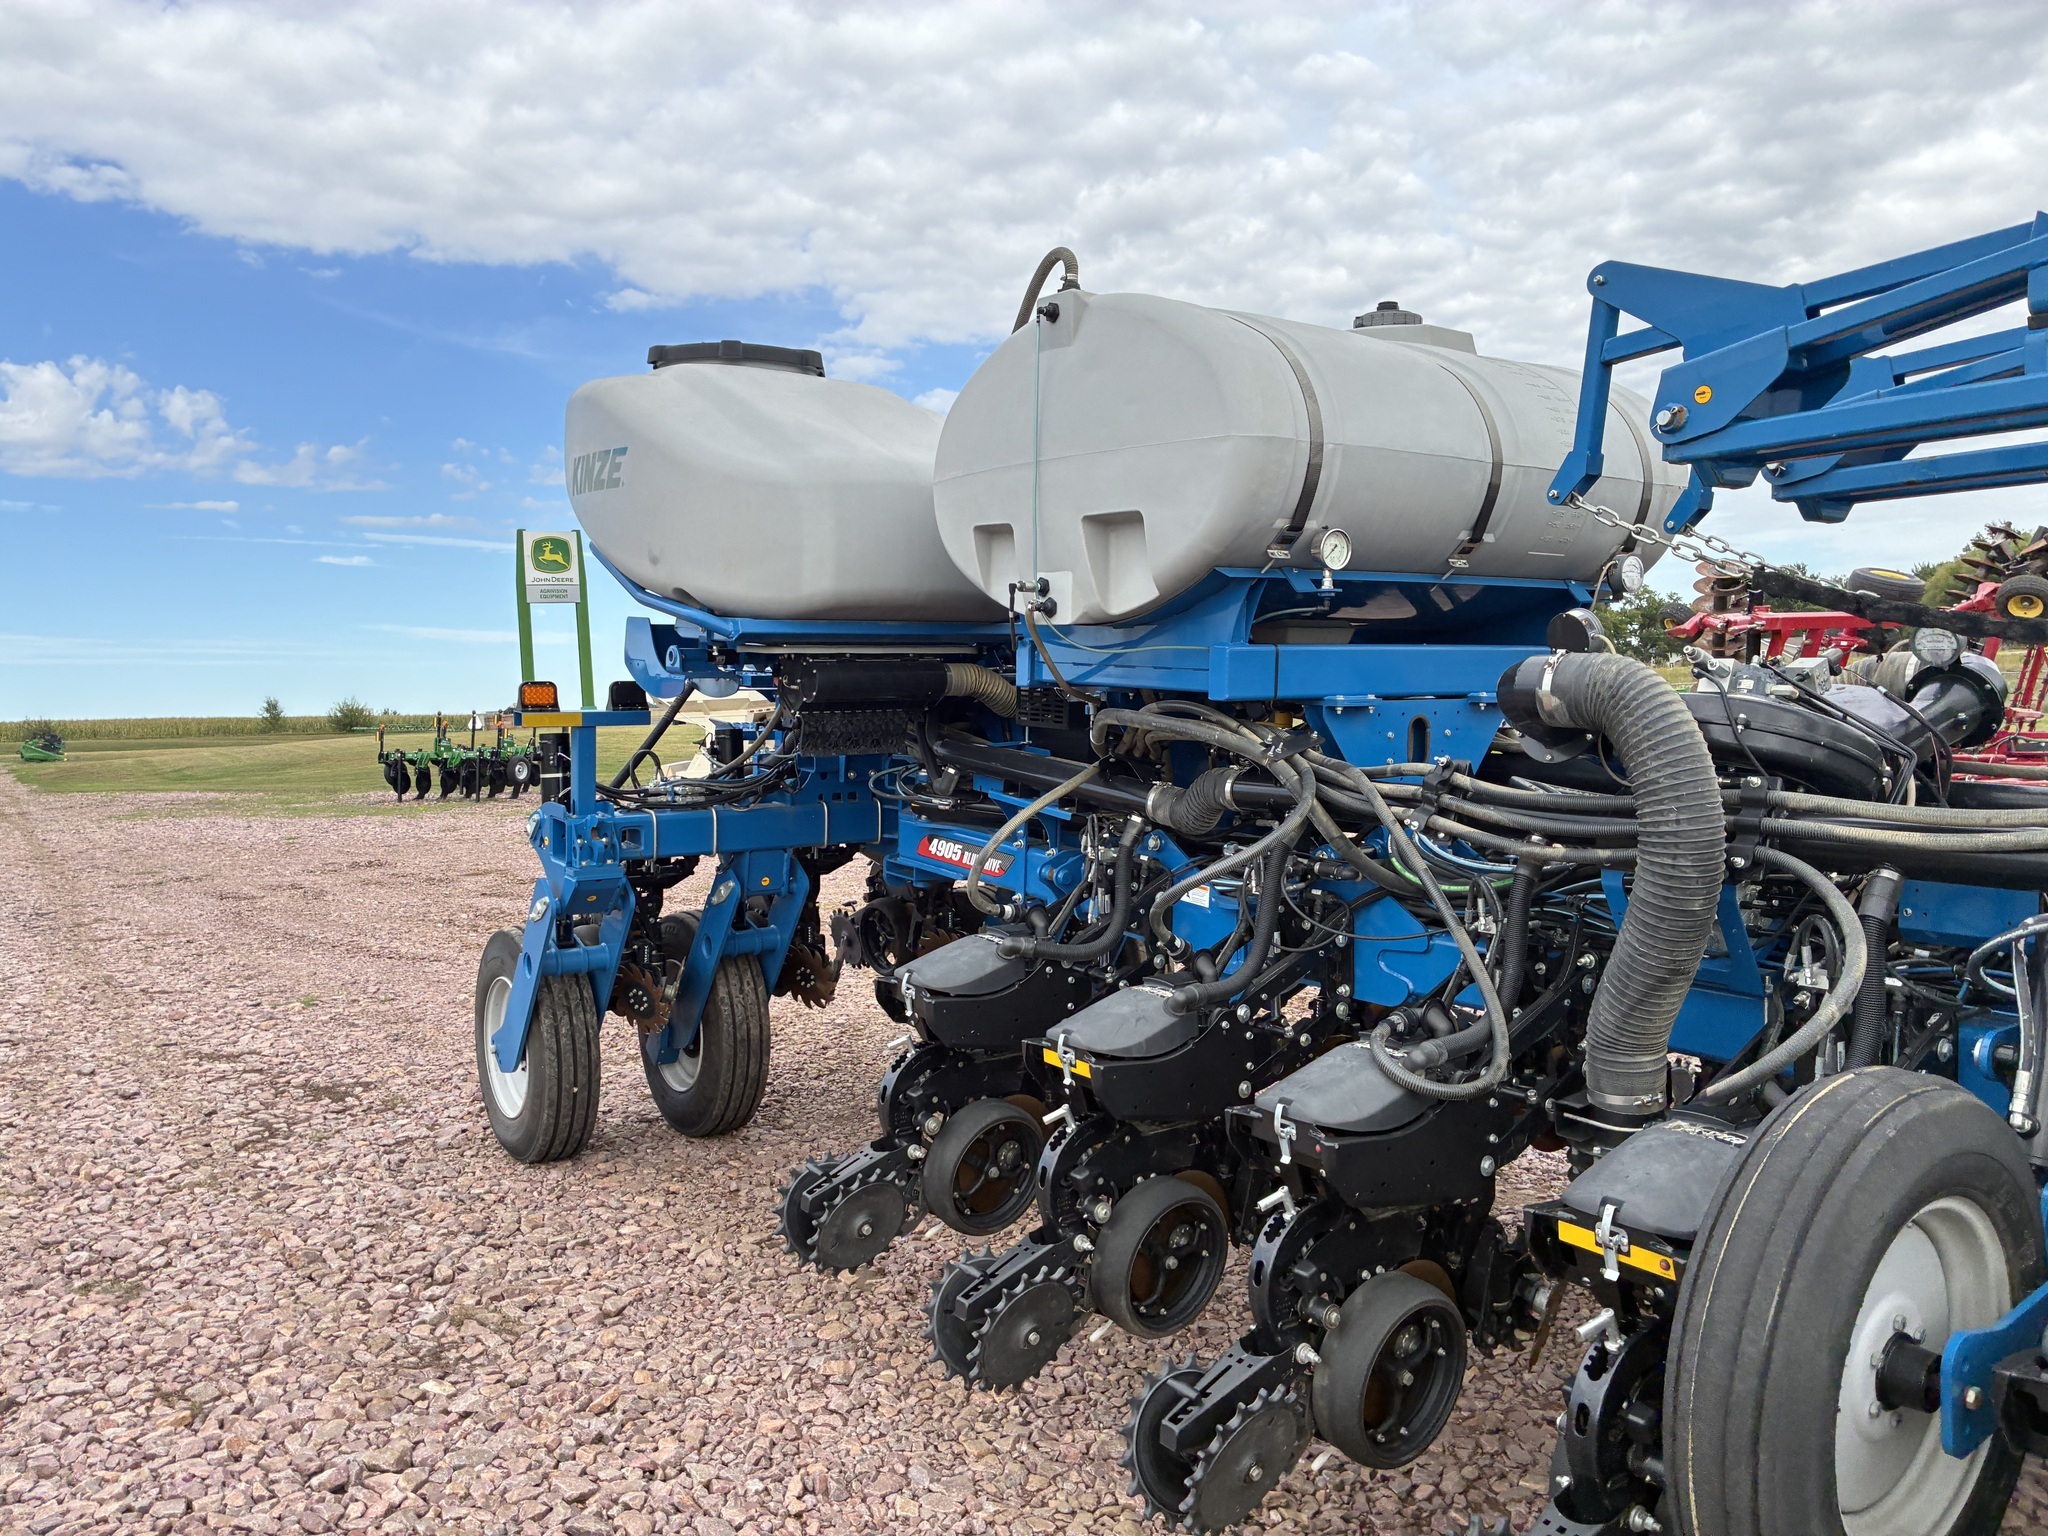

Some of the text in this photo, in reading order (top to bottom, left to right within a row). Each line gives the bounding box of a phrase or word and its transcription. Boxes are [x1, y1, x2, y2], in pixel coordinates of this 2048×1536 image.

[573, 447, 628, 496] KINZE
[929, 838, 1002, 873] 4905 BLU RIVE
